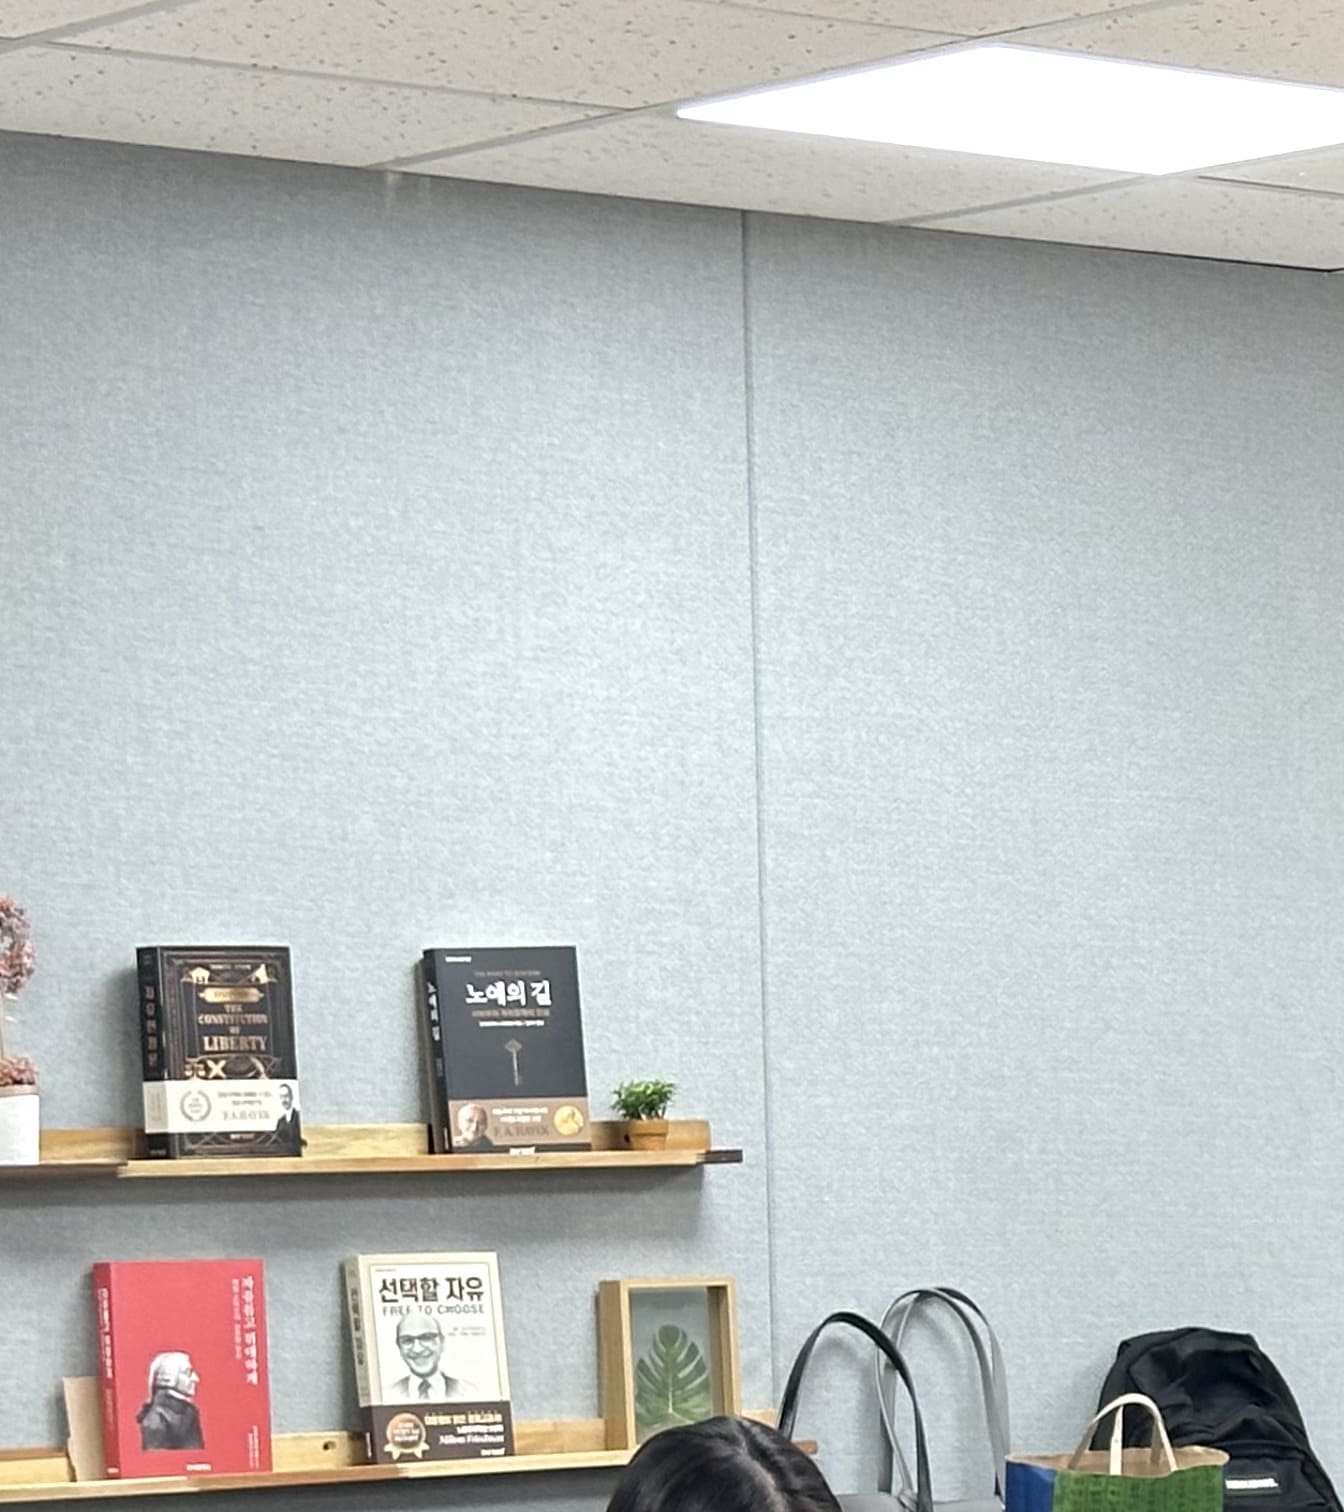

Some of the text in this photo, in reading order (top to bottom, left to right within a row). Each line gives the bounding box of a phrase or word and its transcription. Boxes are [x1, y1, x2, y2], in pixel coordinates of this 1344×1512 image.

[465, 979, 552, 1006] 노예의 길
[198, 1013, 268, 1025] CONSTITUTION
[203, 1035, 268, 1051] LIBERTY
[379, 1276, 485, 1303] 선택할 자유
[382, 1303, 485, 1317] FREE TO CHOOSE
